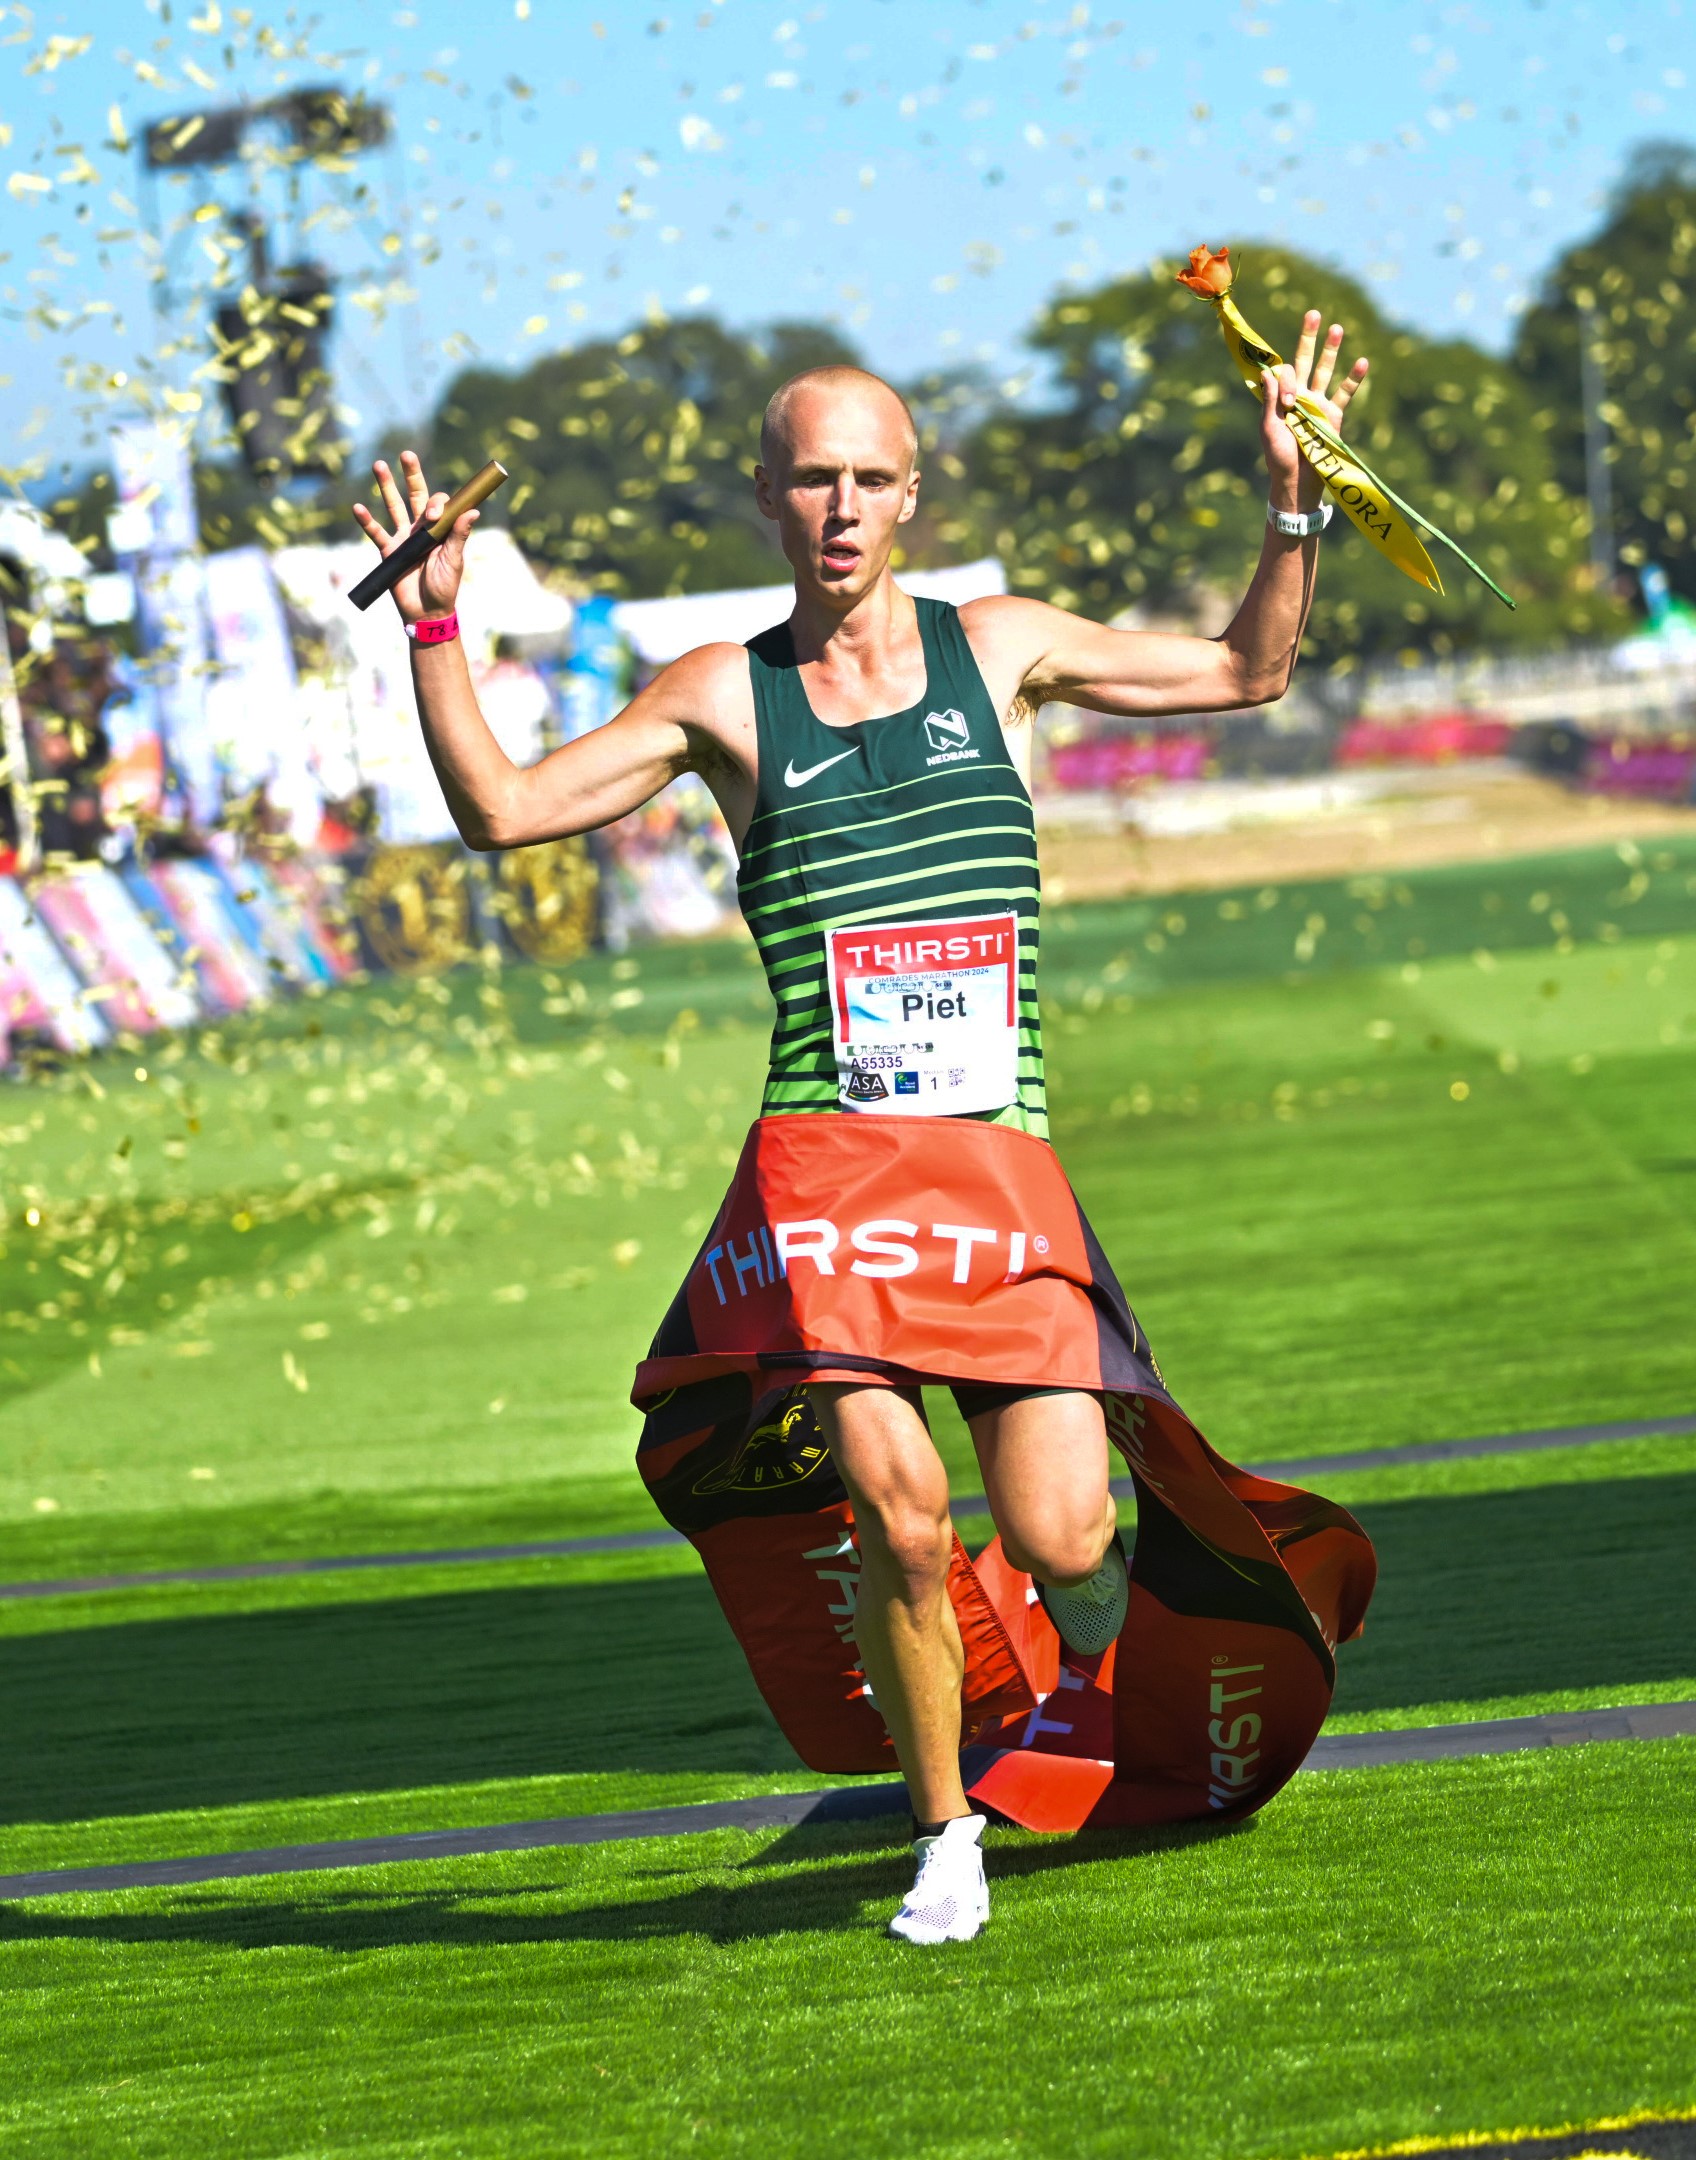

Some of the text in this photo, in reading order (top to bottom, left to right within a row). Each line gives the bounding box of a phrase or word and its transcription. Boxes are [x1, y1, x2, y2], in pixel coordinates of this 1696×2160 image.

[1283, 406, 1393, 542] ERFLORA
[926, 748, 980, 766] NEDBANK
[846, 932, 1004, 968] THIRSTI
[868, 967, 989, 984] COMRADES MARATHON 2024
[902, 991, 967, 1022] Piet
[851, 1056, 903, 1070] A55335
[851, 1075, 883, 1090] ASA
[930, 1077, 937, 1091] 1
